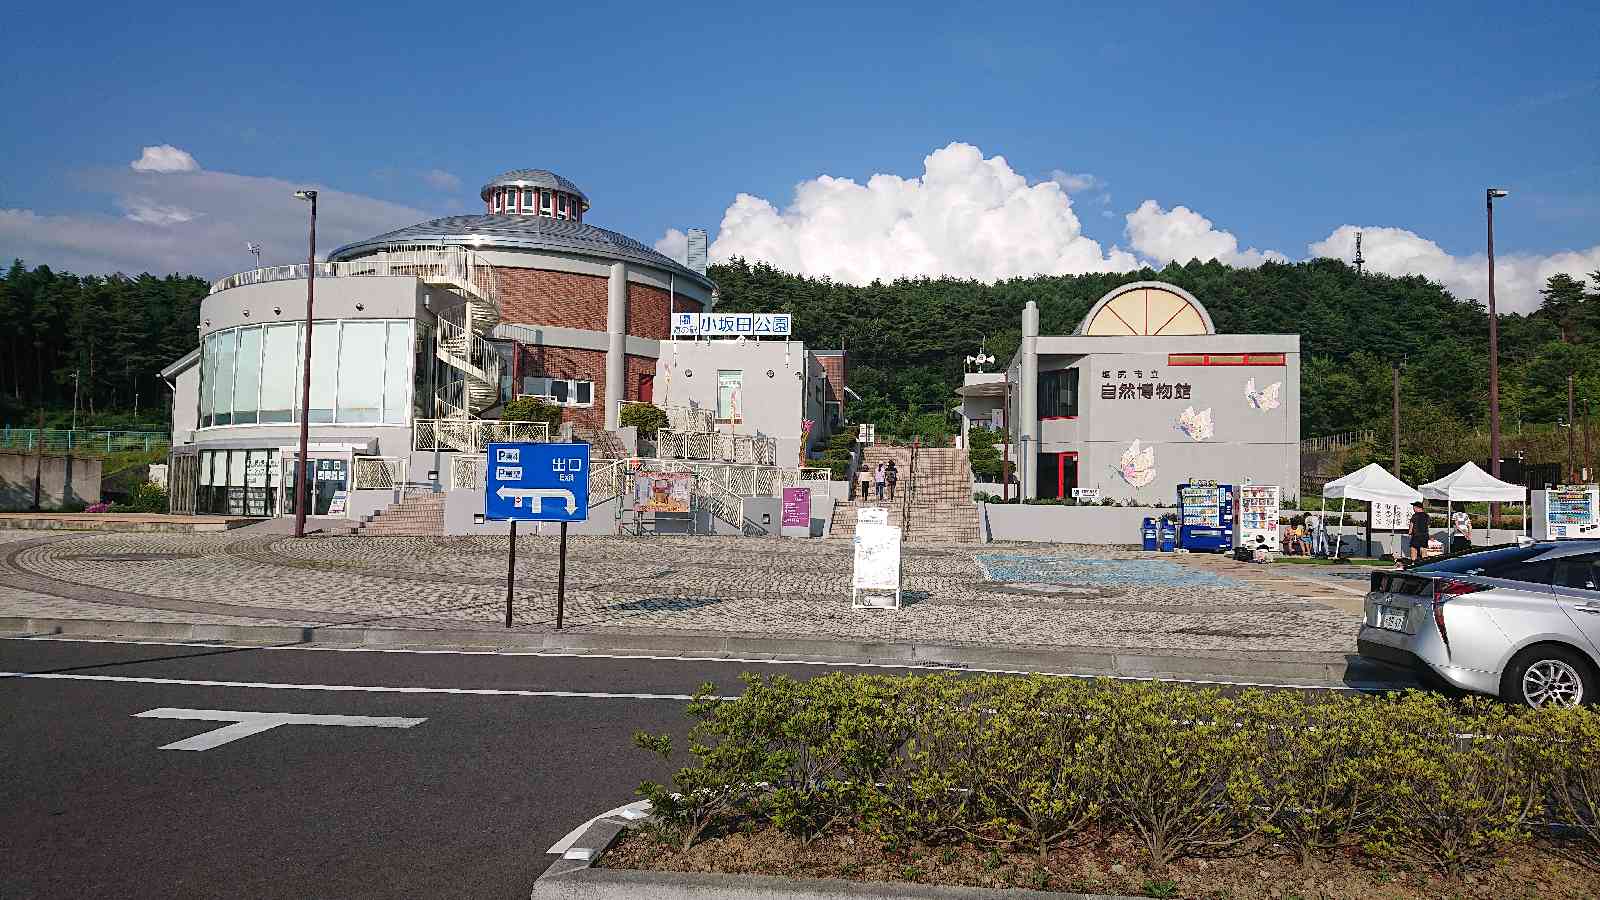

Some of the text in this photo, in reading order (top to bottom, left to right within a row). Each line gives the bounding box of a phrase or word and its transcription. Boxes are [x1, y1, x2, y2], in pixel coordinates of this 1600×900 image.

[673, 326, 698, 334] 道の駅
[701, 316, 789, 333] 小坂田公園
[1102, 383, 1191, 400] 自然博物館
[552, 457, 582, 472] 出口
[559, 474, 574, 482] Exit
